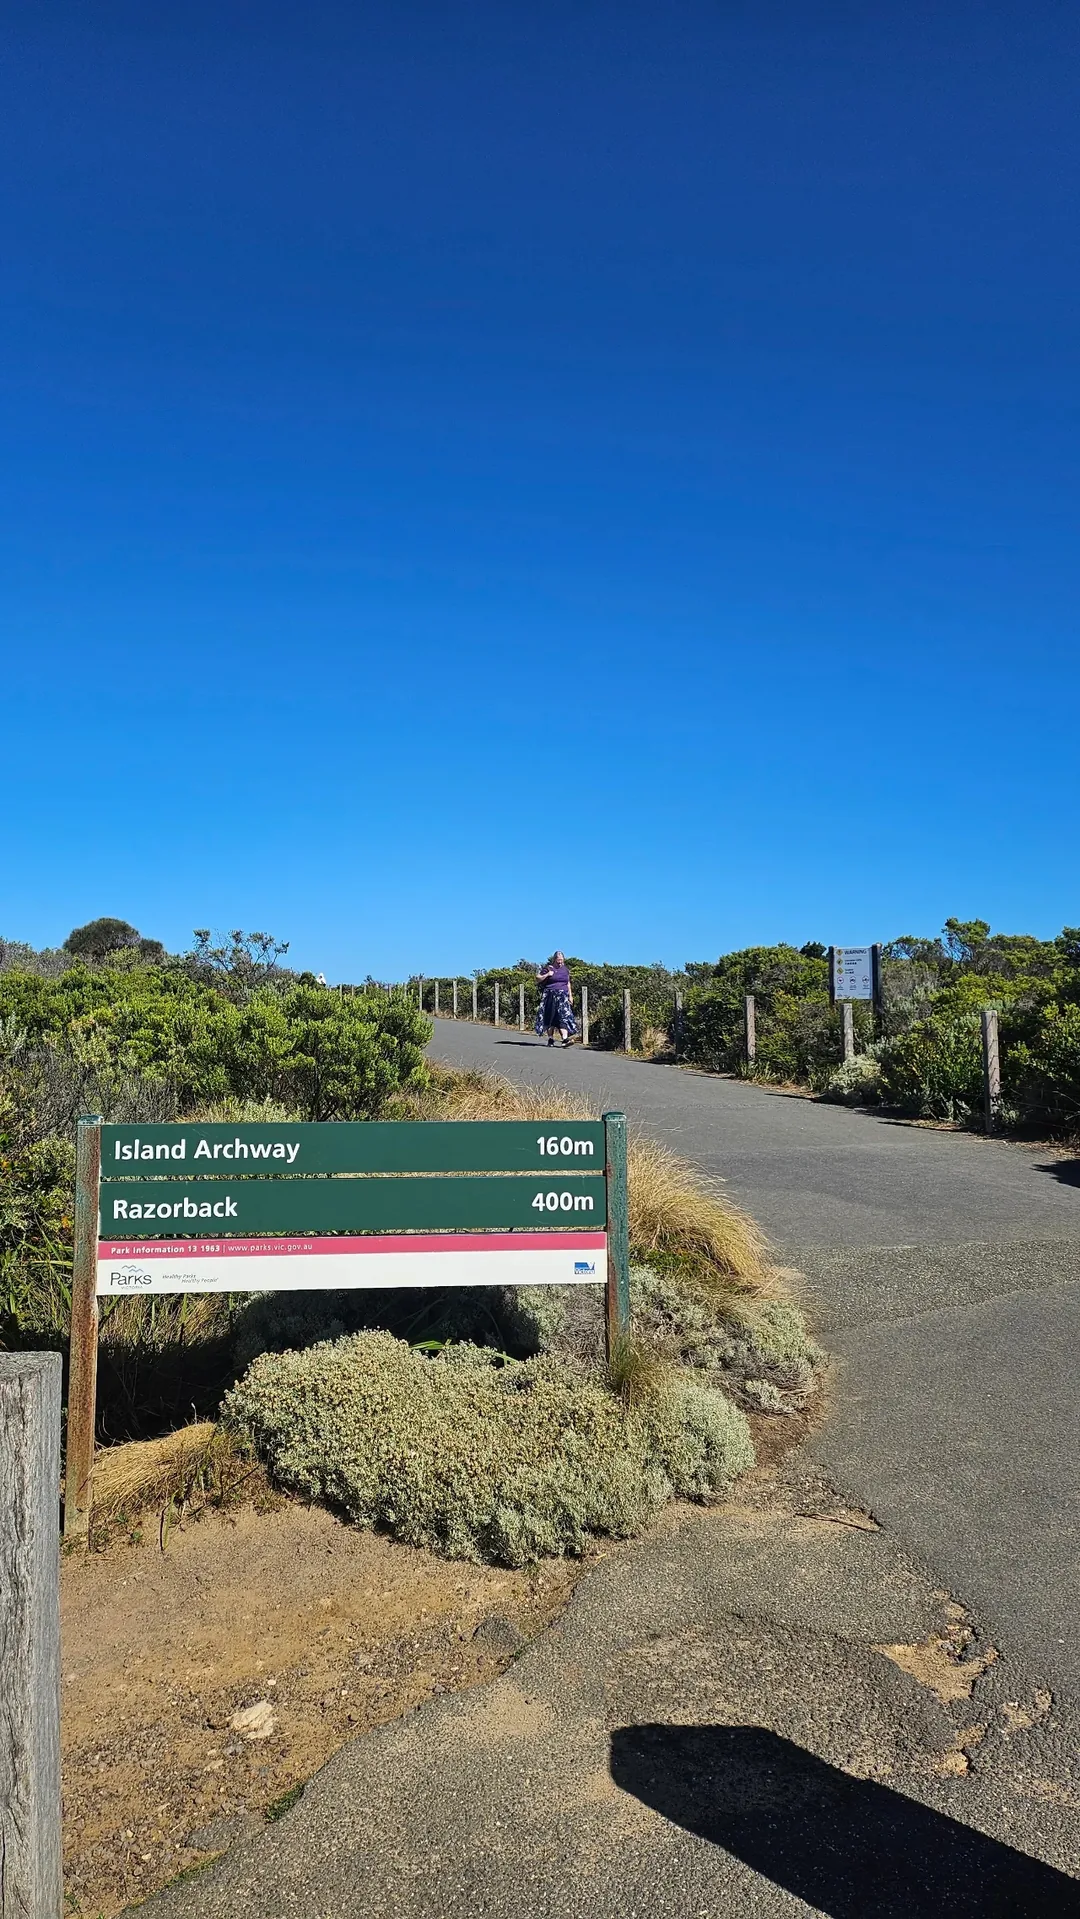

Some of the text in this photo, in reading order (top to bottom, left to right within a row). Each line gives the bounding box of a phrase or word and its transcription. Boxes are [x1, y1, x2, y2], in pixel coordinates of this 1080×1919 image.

[114, 1138, 301, 1163] Island Archway
[536, 1136, 594, 1156] 160m
[113, 1196, 238, 1220] Razorback
[531, 1192, 594, 1212] 400m
[111, 1243, 313, 1255] Park Information 13 1963 www.parks.vic.gov.au
[110, 1272, 152, 1286] Parks
